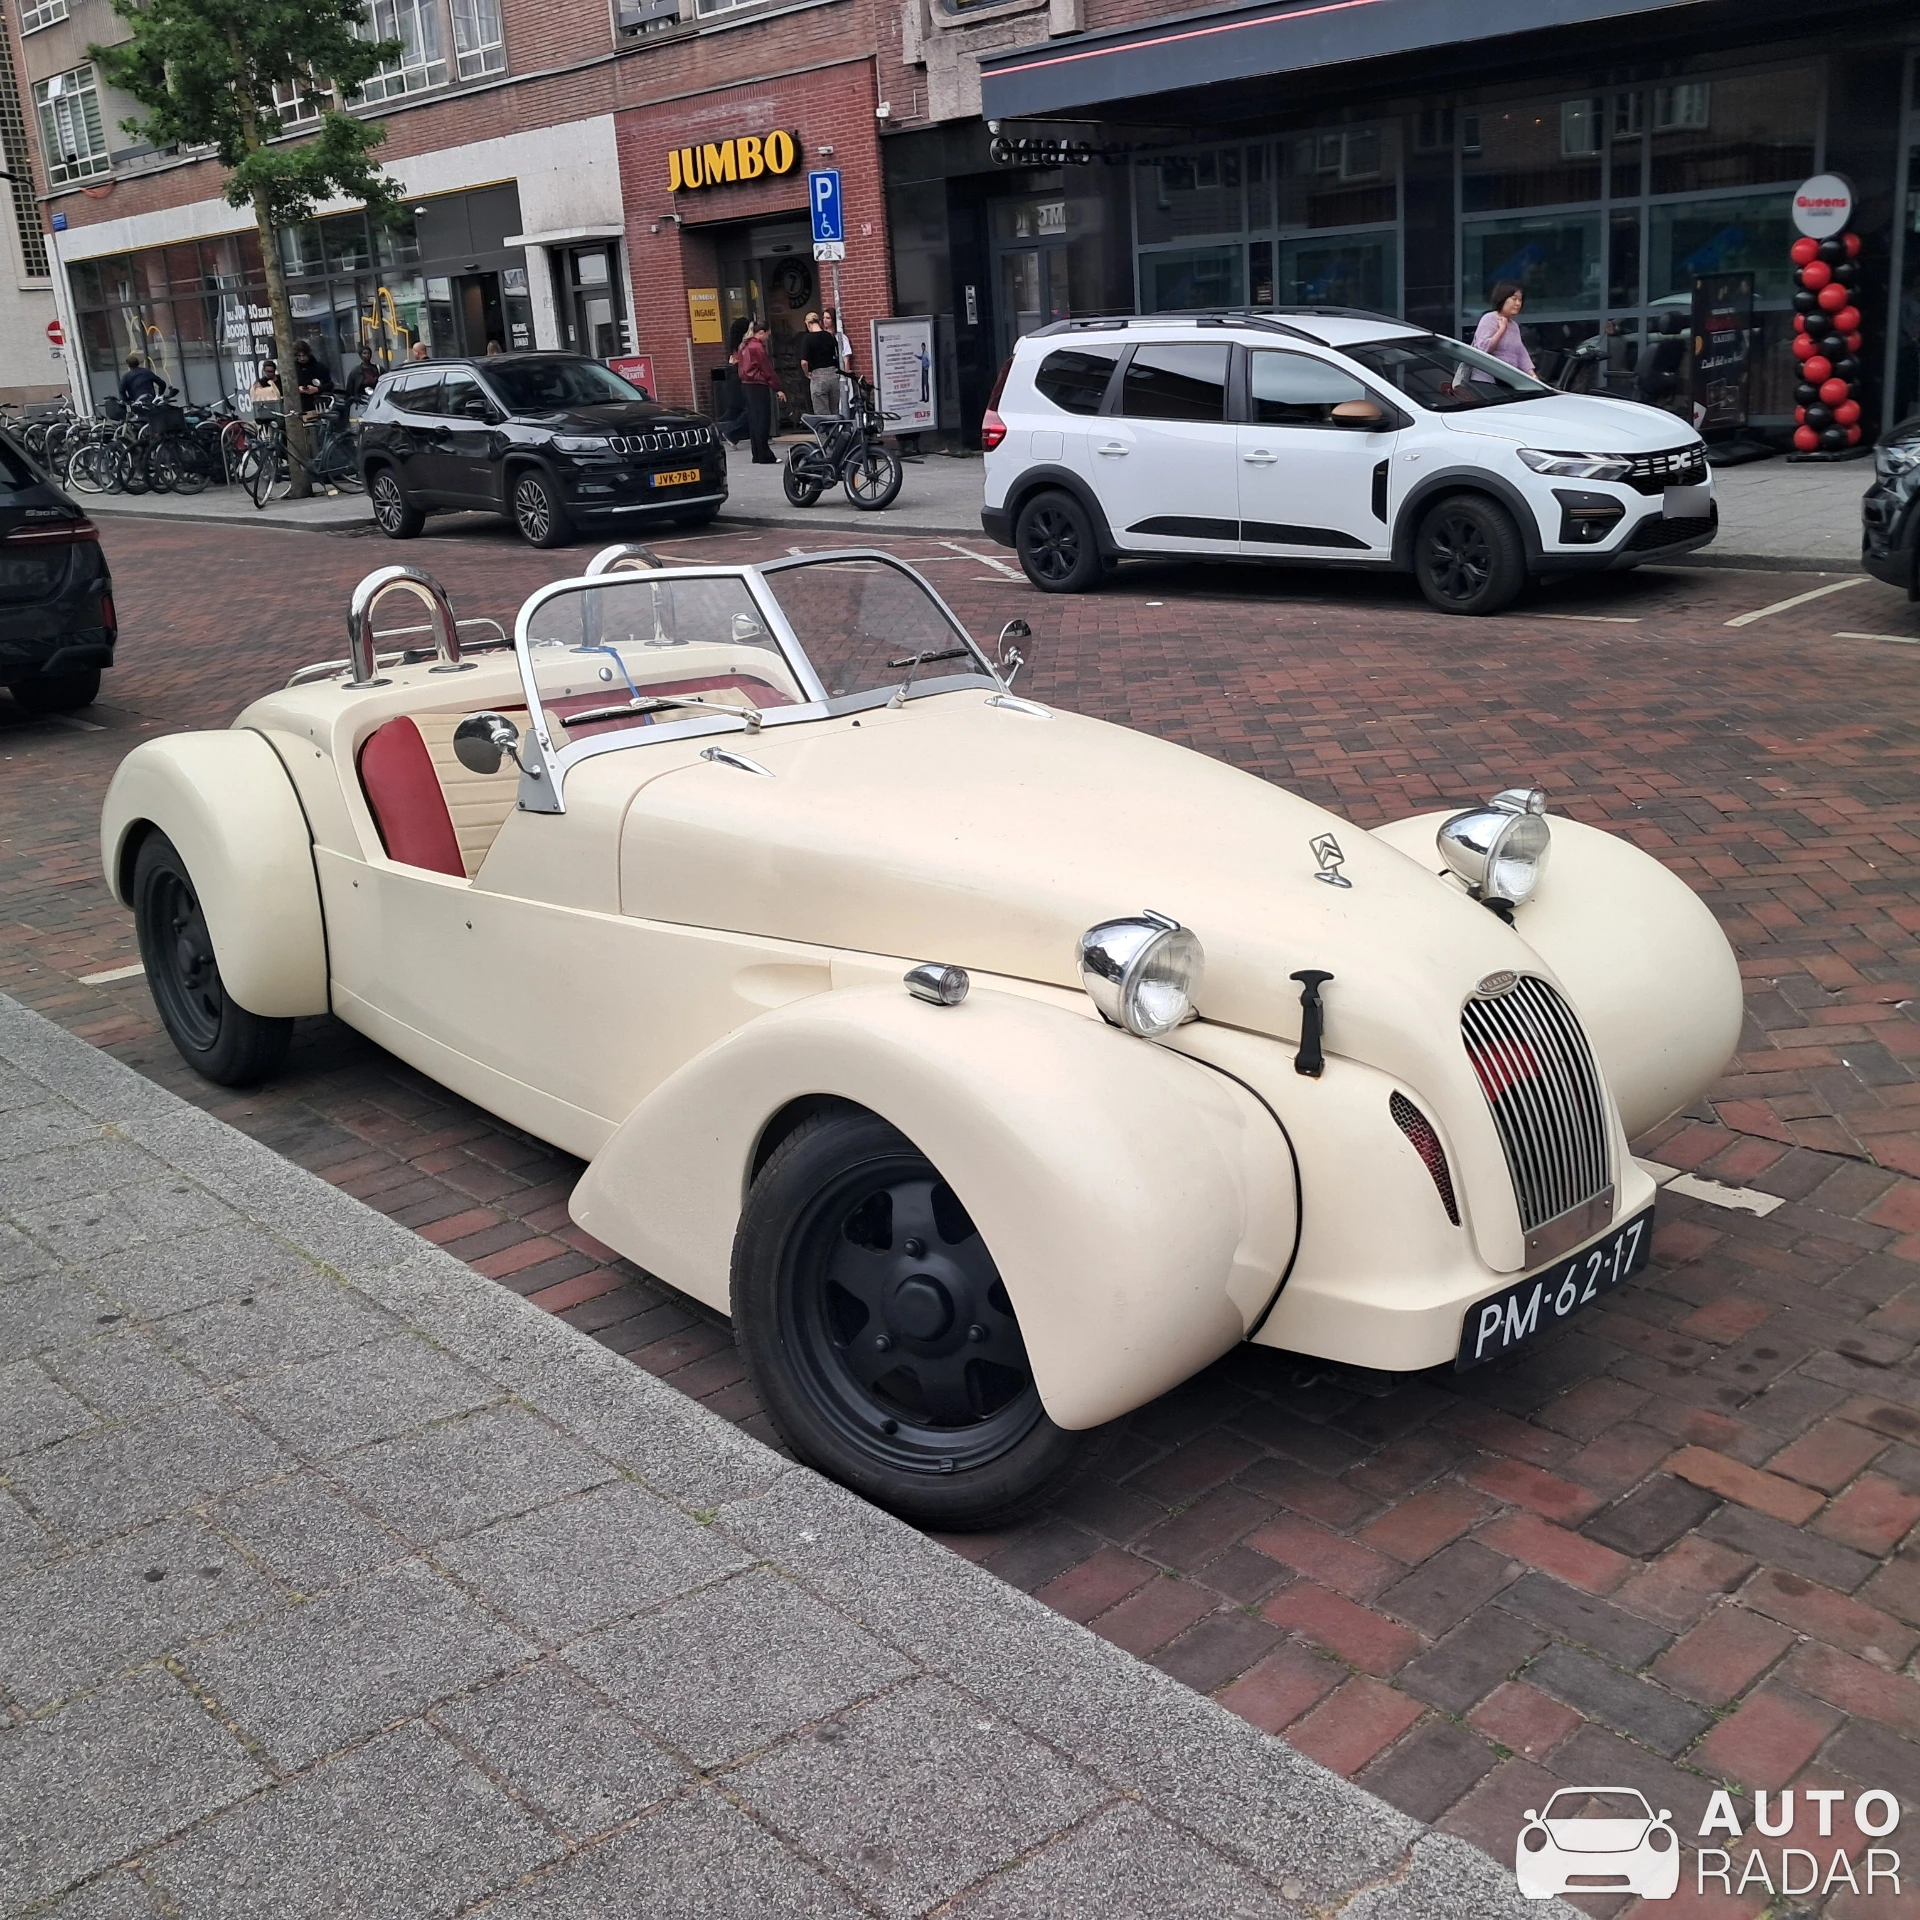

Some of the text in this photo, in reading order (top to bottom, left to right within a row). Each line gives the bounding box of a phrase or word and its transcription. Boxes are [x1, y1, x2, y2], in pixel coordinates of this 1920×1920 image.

[667, 129, 794, 192] JUMBO
[815, 177, 833, 212] P
[1796, 196, 1847, 208] Queens
[694, 309, 716, 317] INGANG
[238, 337, 269, 359] elke dag
[657, 471, 697, 485] JVK-78-D
[1481, 973, 1514, 990] BURTON
[1474, 1219, 1645, 1359] PM-62-17
